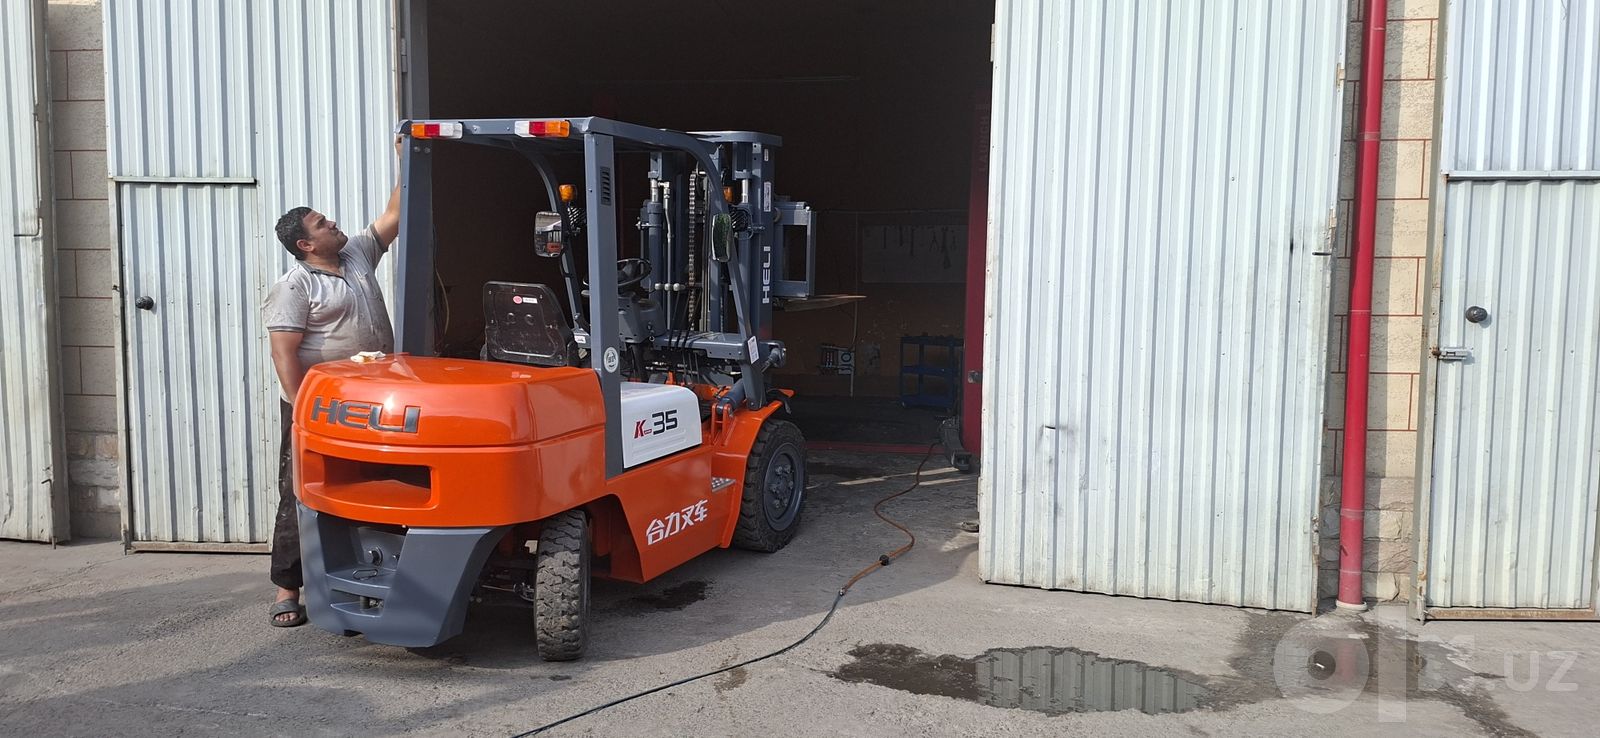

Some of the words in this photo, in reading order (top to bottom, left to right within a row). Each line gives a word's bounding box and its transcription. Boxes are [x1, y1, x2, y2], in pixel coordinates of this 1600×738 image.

[762, 246, 771, 304] HELI
[309, 396, 421, 433] HELI
[646, 499, 708, 545] 合力叉车
